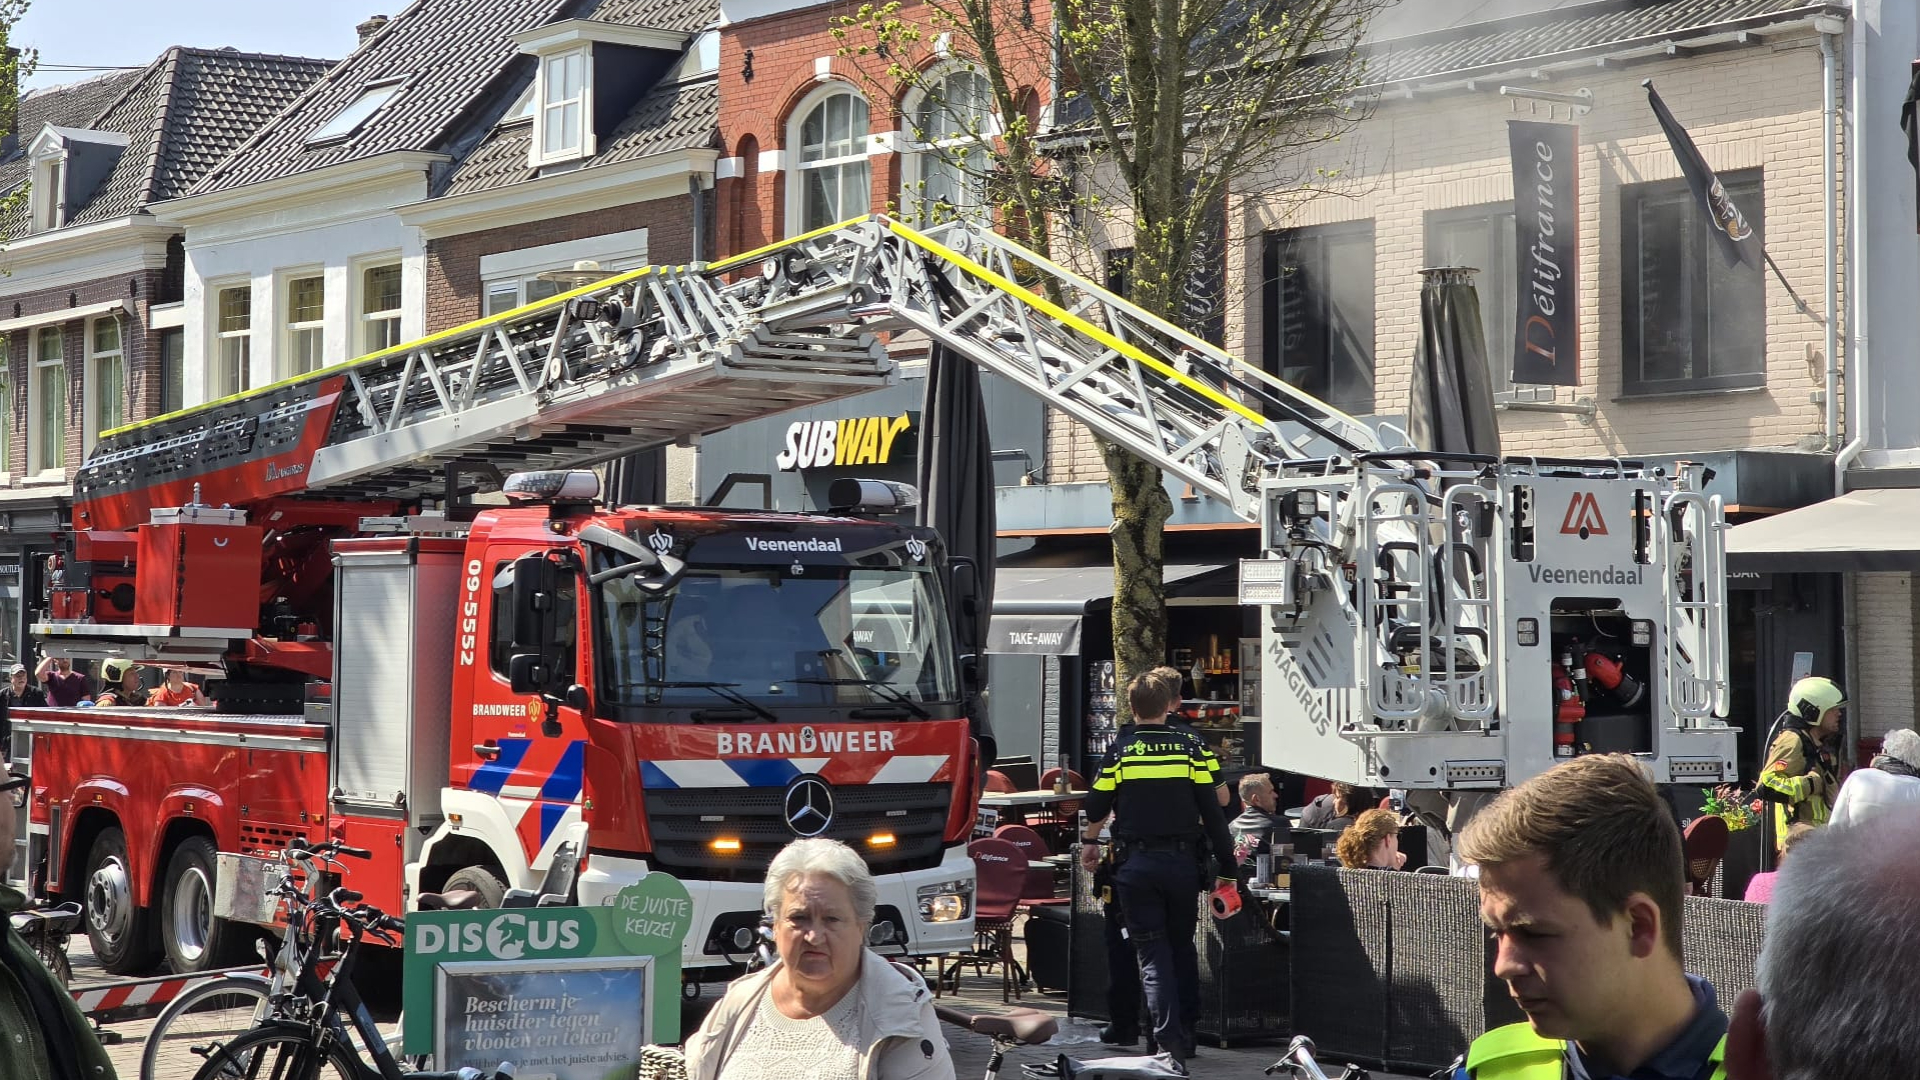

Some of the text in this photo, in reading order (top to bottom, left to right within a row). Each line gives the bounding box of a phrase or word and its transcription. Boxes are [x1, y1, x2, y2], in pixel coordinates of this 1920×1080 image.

[1525, 141, 1562, 367] Délifrance
[776, 412, 910, 471] SUBWAY
[746, 537, 842, 552] Veenendaal
[1528, 564, 1643, 585] Veenendaal
[460, 559, 482, 666] 09-5552
[1009, 632, 1063, 645] TAKE-AWAY
[1268, 639, 1330, 737] MAGIRUS
[473, 704, 526, 717] BRANDWEER
[717, 730, 895, 755] BRANDWEER
[621, 894, 688, 917] DE JUISTE
[416, 914, 580, 959] DISCUS
[625, 917, 676, 939] KEUZE!
[465, 993, 577, 1014] Bescherm je
[465, 1012, 600, 1032] huisdier tegen
[465, 1027, 619, 1051] vlooien en teken!
[519, 1057, 529, 1068] je
[530, 1056, 549, 1066] met
[551, 1055, 567, 1065] het
[568, 1054, 596, 1066] juiste
[597, 1052, 629, 1064] advies.
